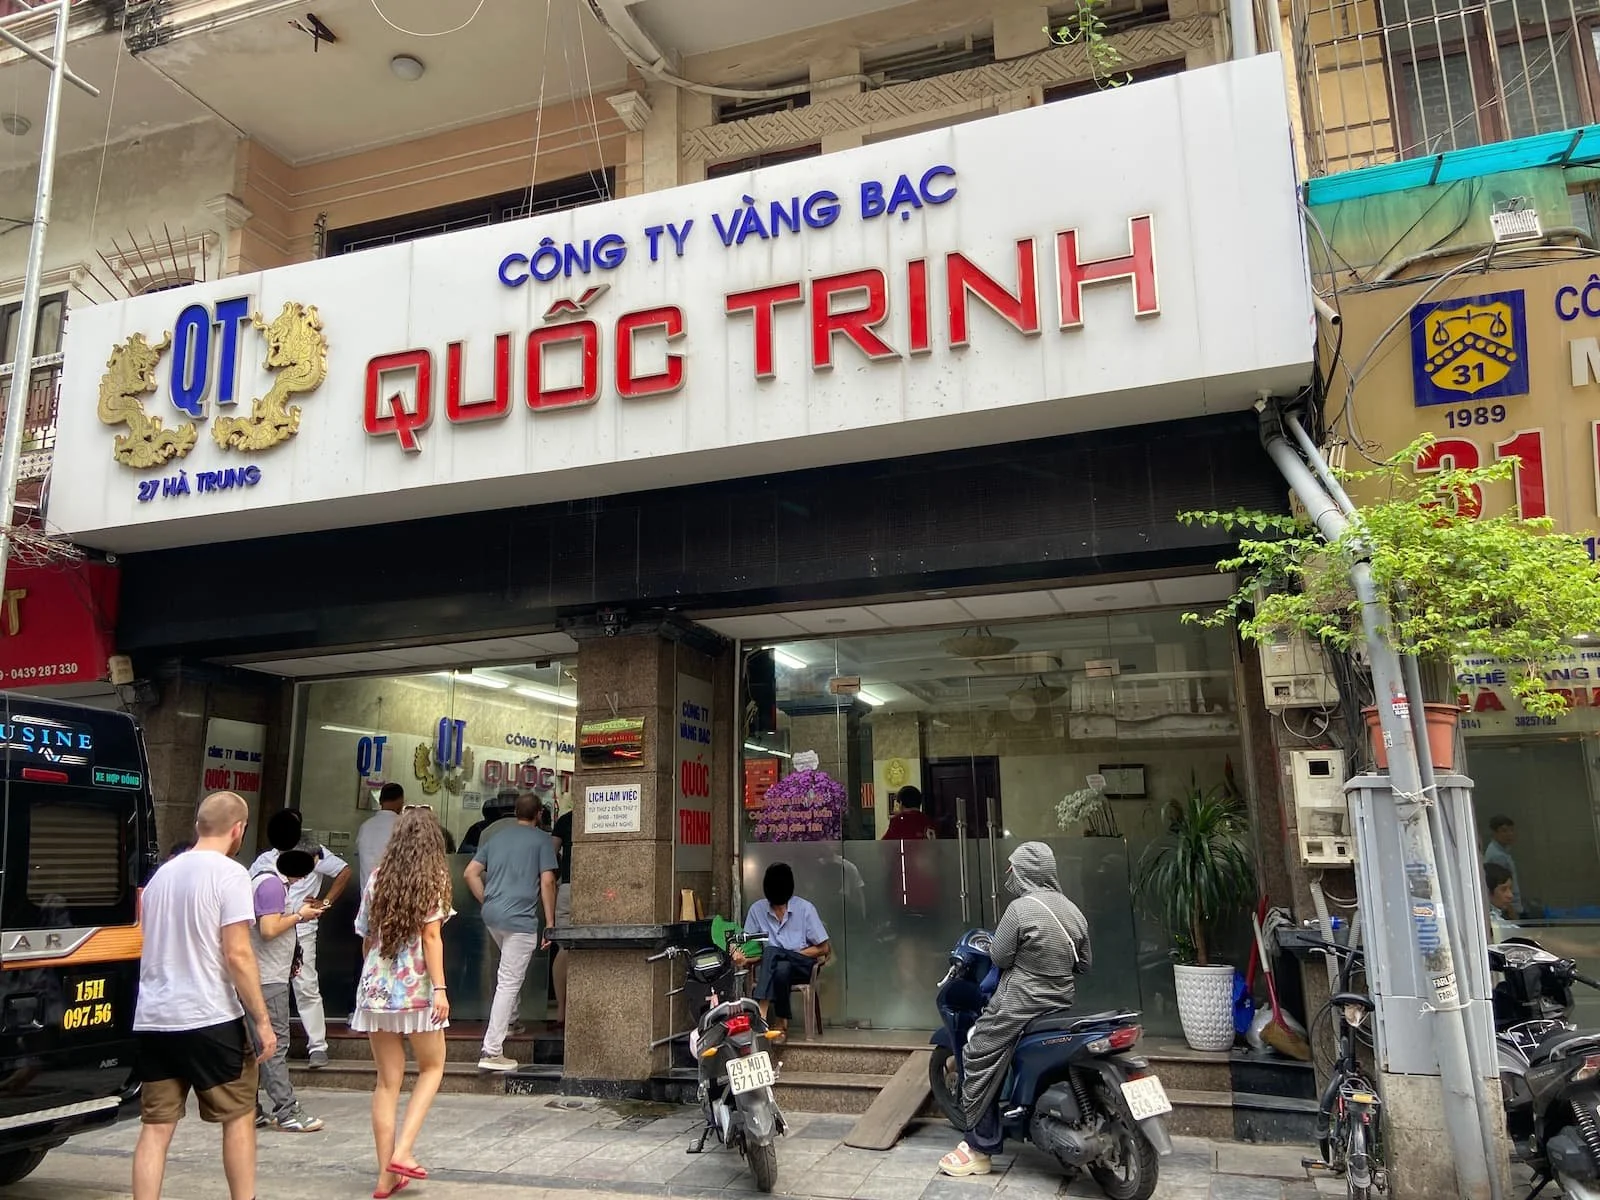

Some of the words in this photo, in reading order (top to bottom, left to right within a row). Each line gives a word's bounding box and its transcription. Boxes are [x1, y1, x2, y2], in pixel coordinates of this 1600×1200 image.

[498, 234, 627, 288] CÔNG
[644, 218, 693, 263] TY
[712, 190, 841, 247] VÀNG
[860, 164, 958, 222] BẠC
[364, 283, 688, 453] QUỐC
[725, 213, 1162, 381] TRINH
[168, 295, 253, 419] QT
[1450, 361, 1485, 386] 31
[1444, 404, 1507, 429] 1989
[137, 479, 160, 501] 27
[162, 468, 191, 498] HÀ
[195, 464, 262, 493] TRUNG
[1412, 427, 1549, 529] 31
[11, 666, 37, 680] 0439
[38, 664, 57, 677] 287
[58, 662, 78, 675] 330
[356, 735, 387, 777] QT
[505, 732, 538, 749] CÔNG
[539, 736, 553, 752] TY
[204, 763, 230, 792] QUỐC
[484, 755, 555, 790] QUỐC
[681, 753, 709, 798] QUỐC
[588, 791, 604, 805] LỊCH
[622, 788, 638, 803] VIỆC
[679, 809, 711, 845] TRINH
[75, 978, 106, 1003] 15H
[63, 1002, 112, 1031] 097.56
[733, 1070, 771, 1091] 571.03
